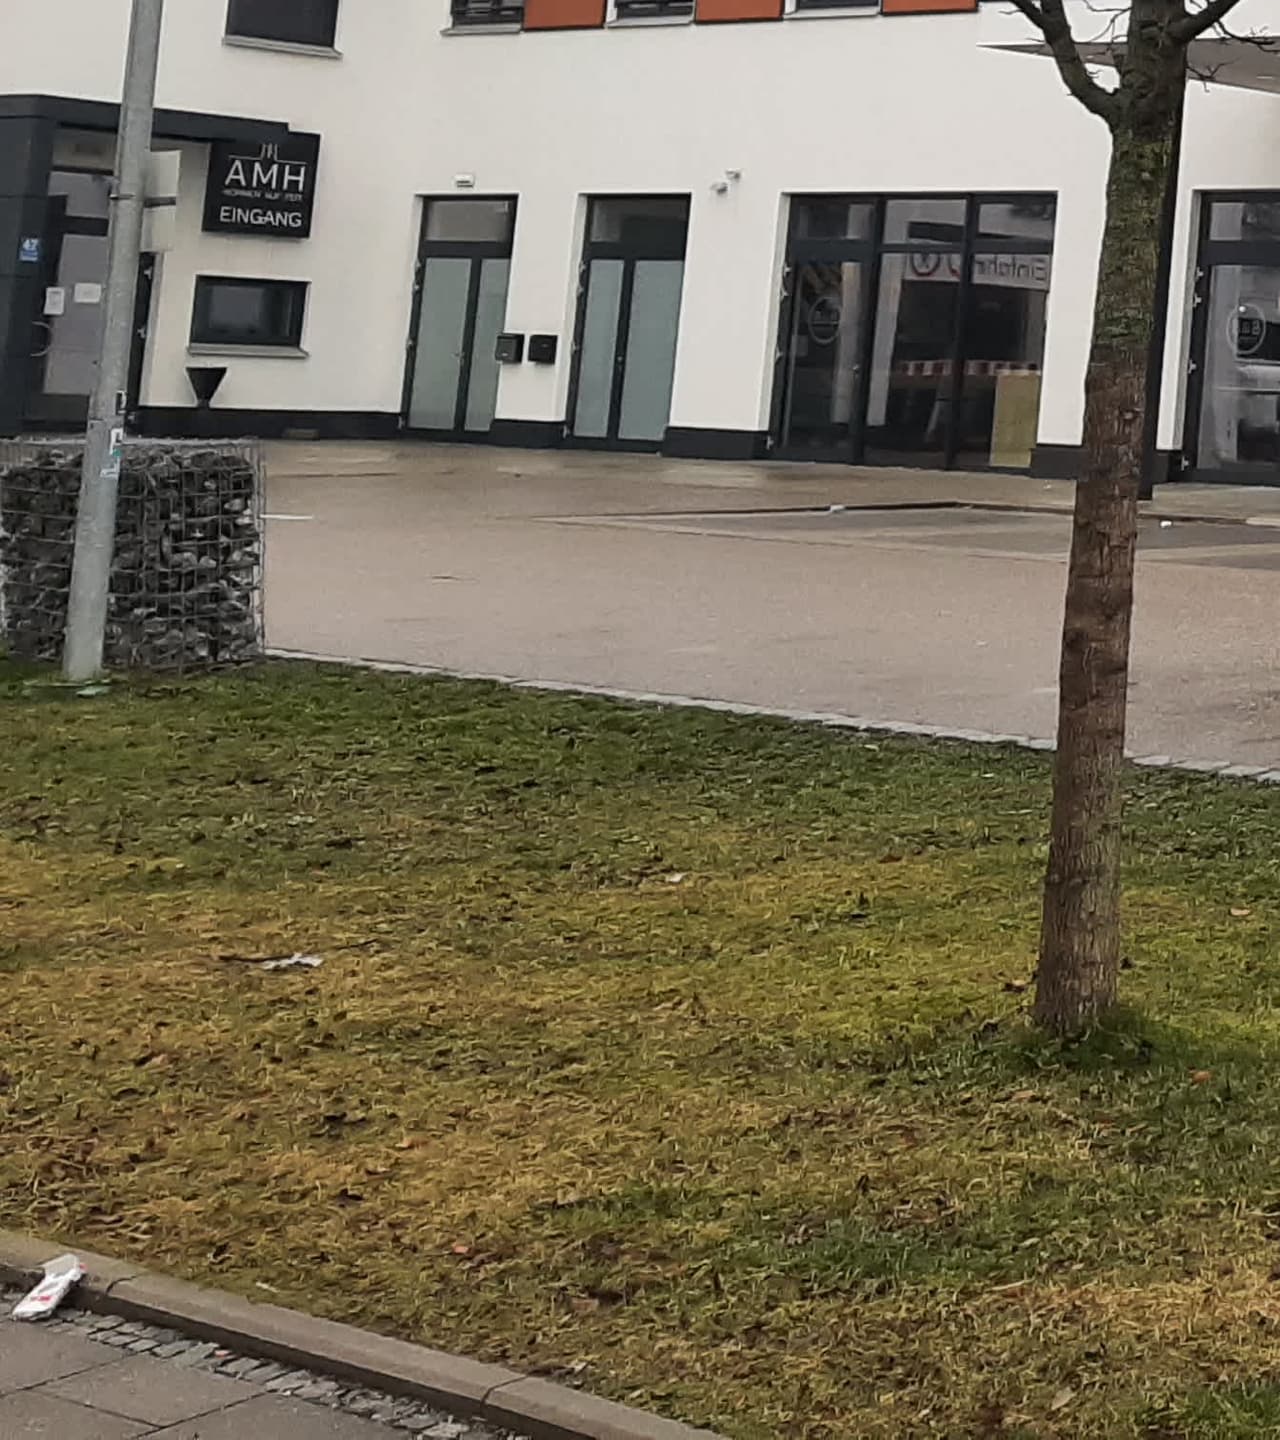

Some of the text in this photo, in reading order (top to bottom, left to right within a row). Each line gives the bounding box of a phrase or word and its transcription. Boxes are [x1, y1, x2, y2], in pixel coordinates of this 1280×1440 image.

[224, 159, 306, 192] AMH
[220, 205, 302, 228] EINGANG
[22, 238, 39, 251] 47
